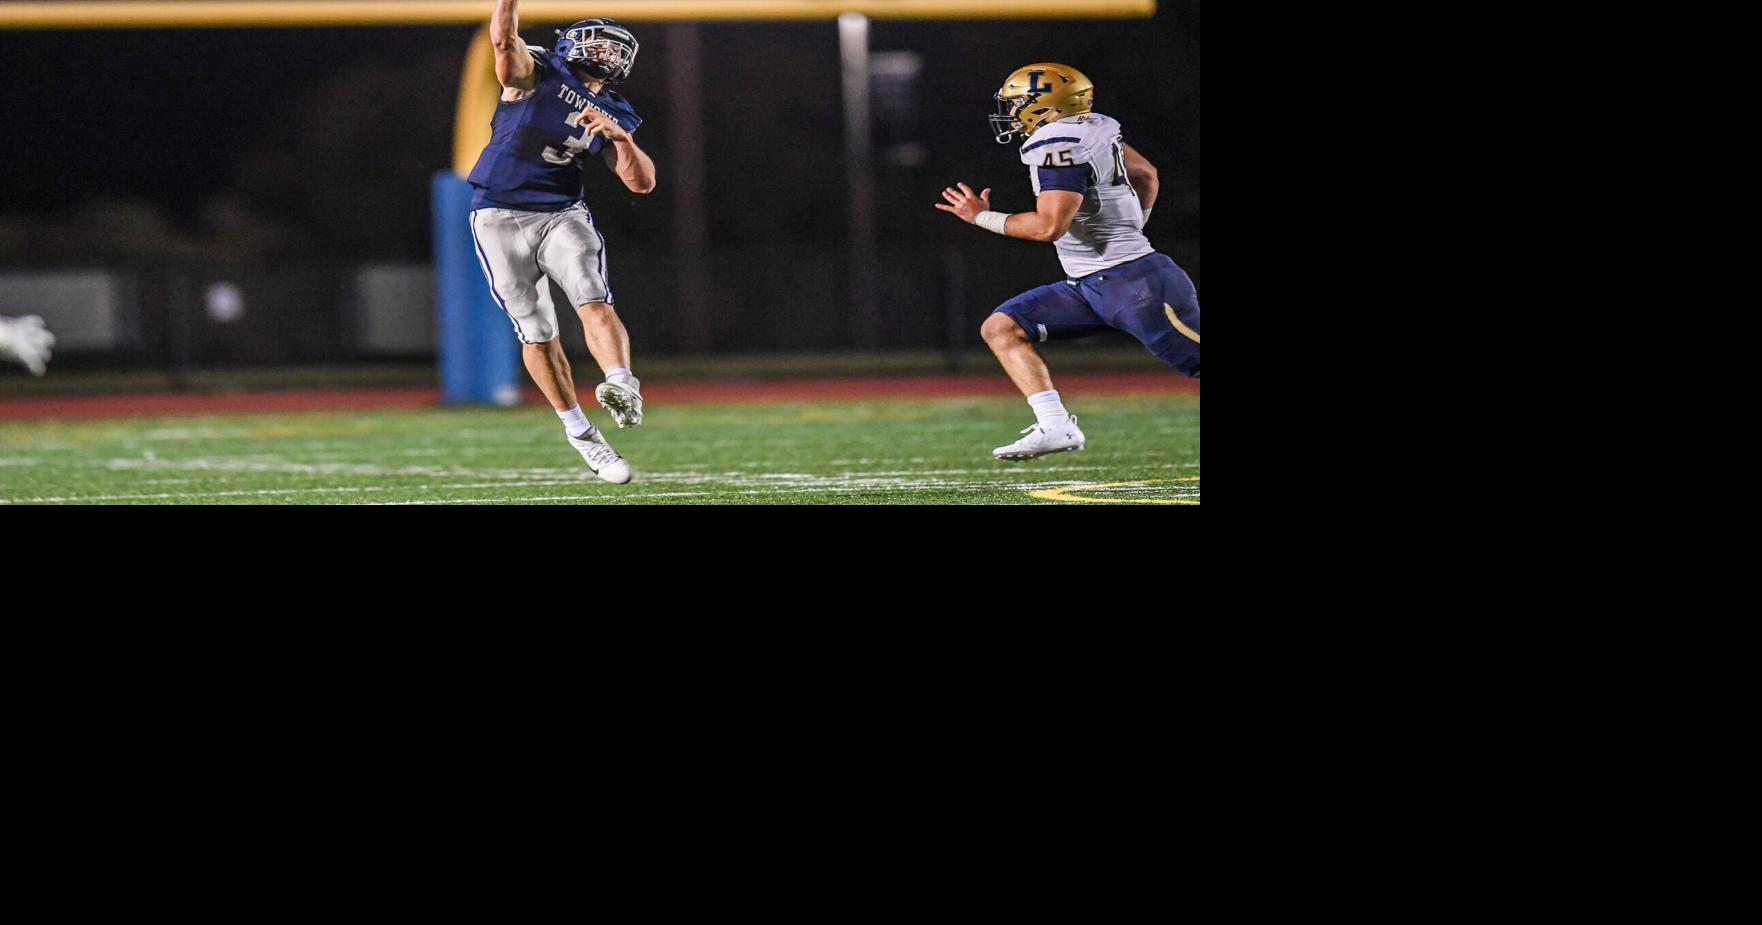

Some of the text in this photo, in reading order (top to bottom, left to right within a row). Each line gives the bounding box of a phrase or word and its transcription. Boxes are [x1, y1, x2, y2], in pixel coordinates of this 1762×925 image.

[1027, 71, 1052, 93] L
[557, 83, 618, 124] TOWN
[541, 111, 596, 165] 3
[1042, 149, 1075, 167] 45
